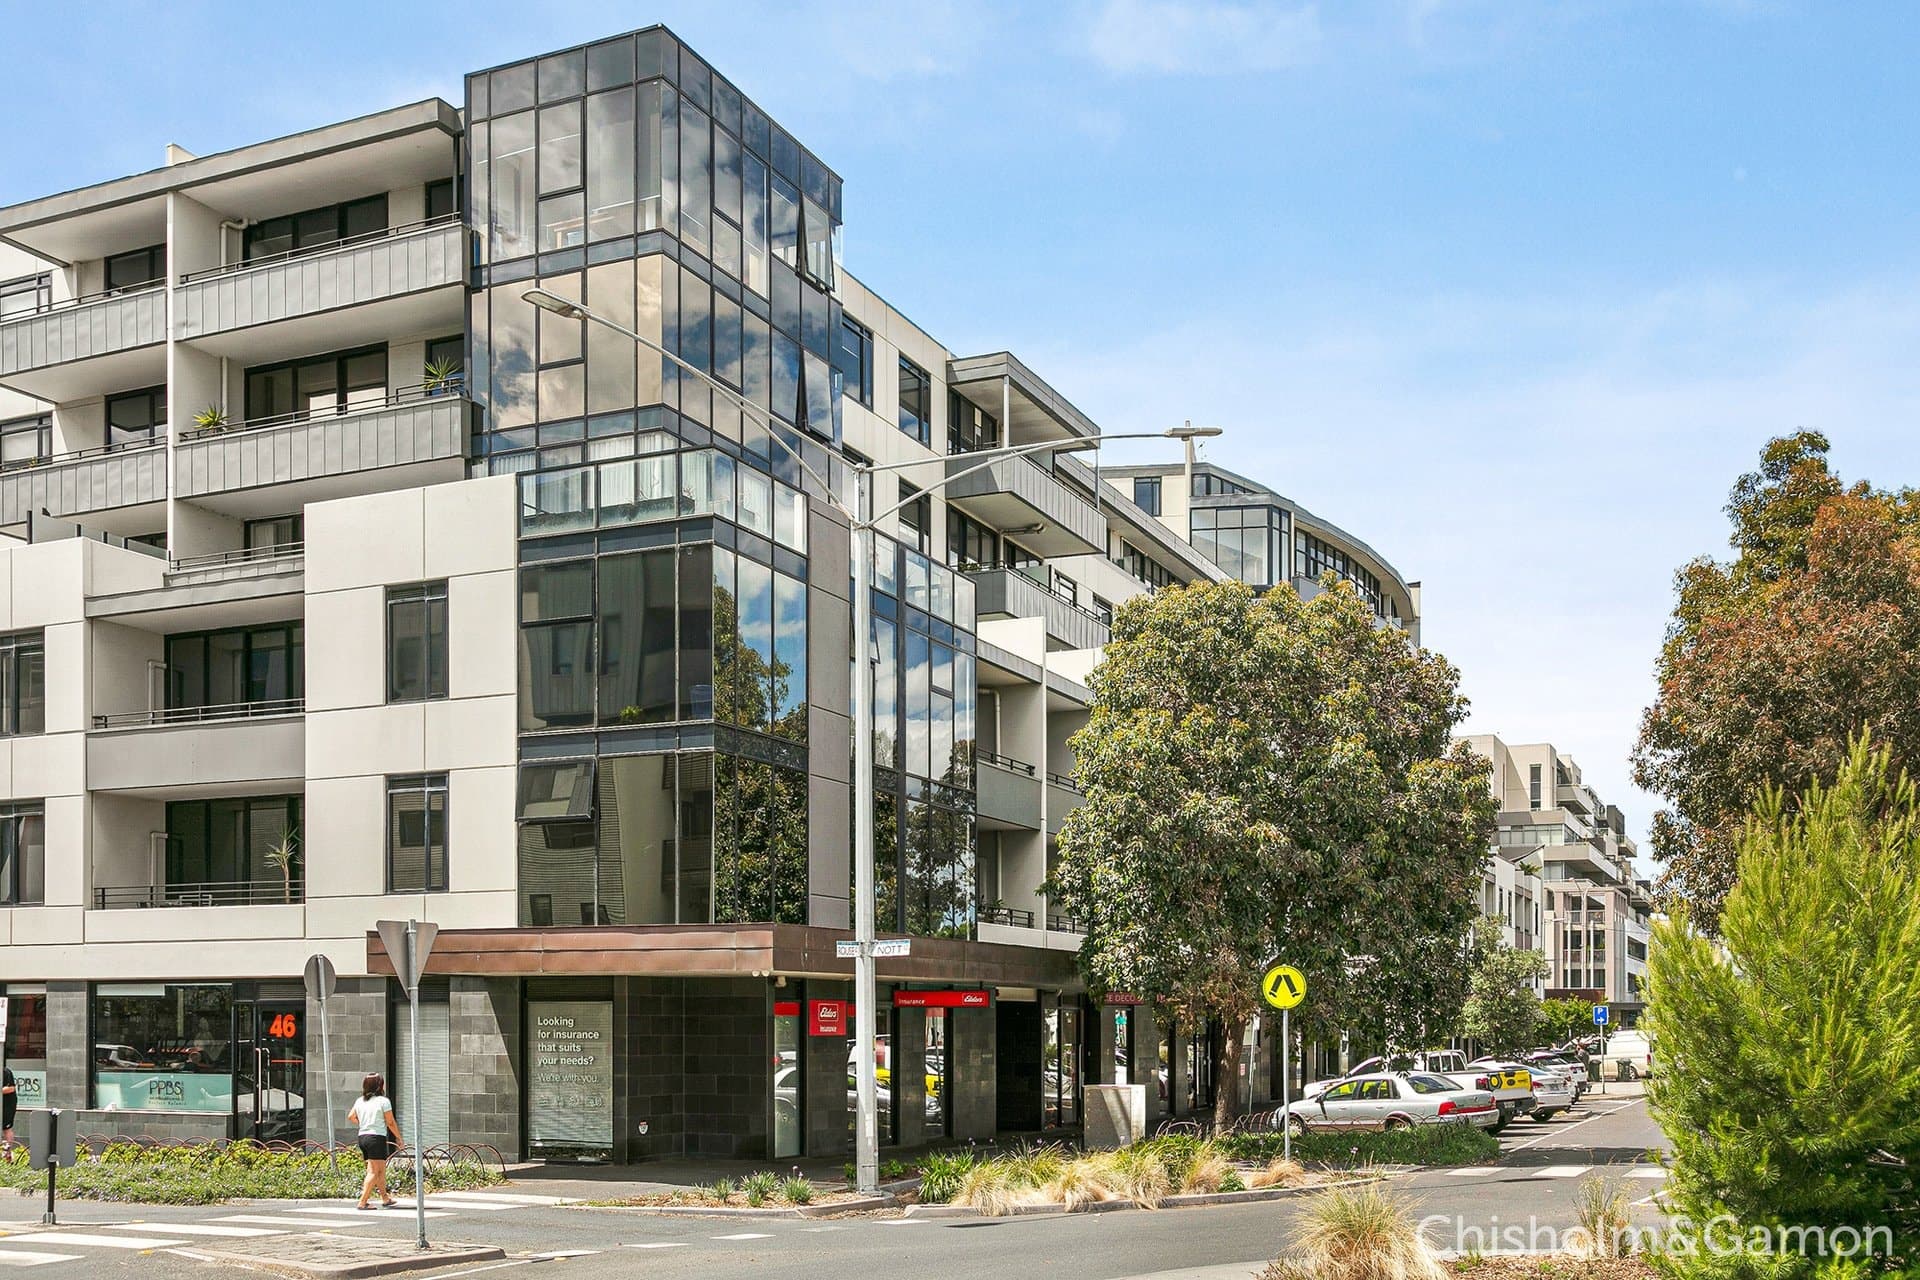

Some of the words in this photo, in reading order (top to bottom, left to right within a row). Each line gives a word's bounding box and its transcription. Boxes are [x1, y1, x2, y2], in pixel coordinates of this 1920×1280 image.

[877, 945, 902, 954] NOTT
[270, 1014, 296, 1038] 46
[537, 1016, 574, 1028] Looking
[537, 1029, 551, 1039] for
[552, 1029, 600, 1039] insurance
[537, 1043, 556, 1052] that
[558, 1043, 582, 1052] suits
[537, 1056, 558, 1066] your
[560, 1055, 594, 1065] needs?
[149, 1080, 182, 1096] PPBS
